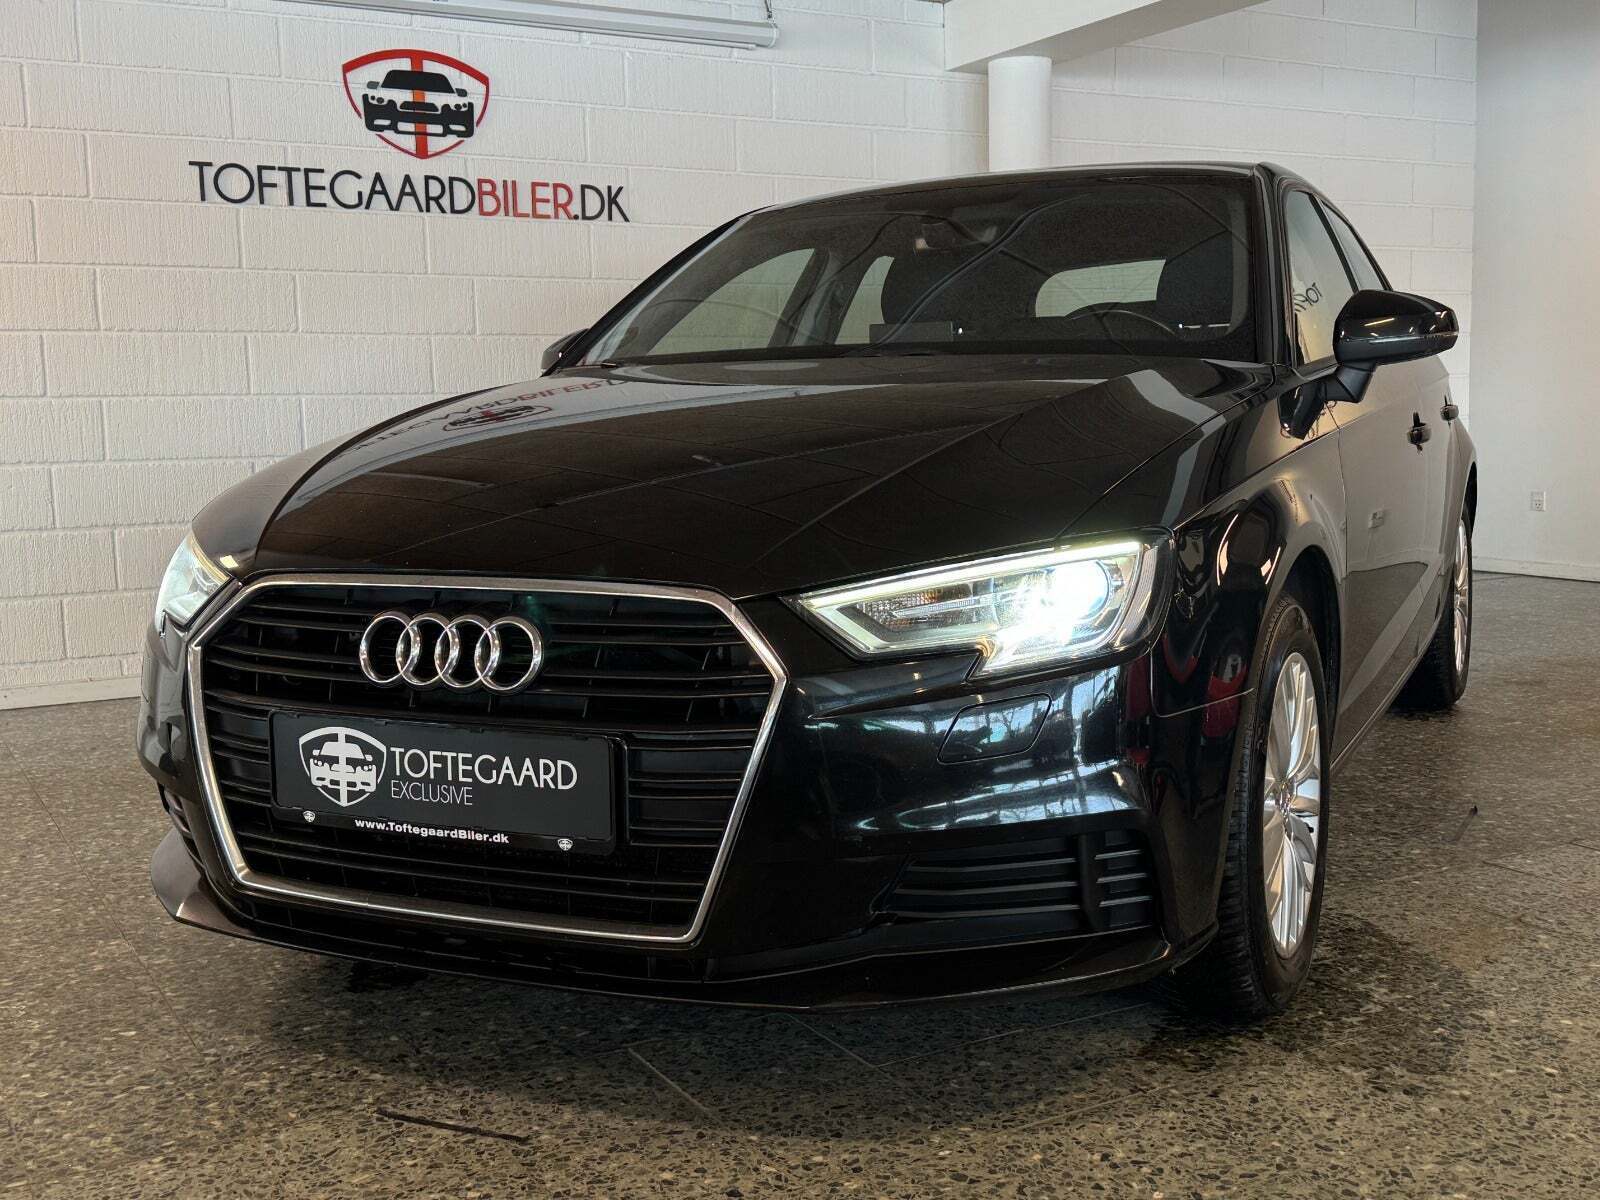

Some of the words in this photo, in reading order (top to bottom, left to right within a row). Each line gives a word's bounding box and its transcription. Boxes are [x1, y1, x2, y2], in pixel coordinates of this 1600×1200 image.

[188, 160, 630, 222] TOFTEGAARDBILER.DK
[390, 747, 578, 790] TOFTEGAARD
[391, 780, 473, 806] EXCLUSIVE
[354, 818, 509, 844] www.ToftegaardBiler.dk
